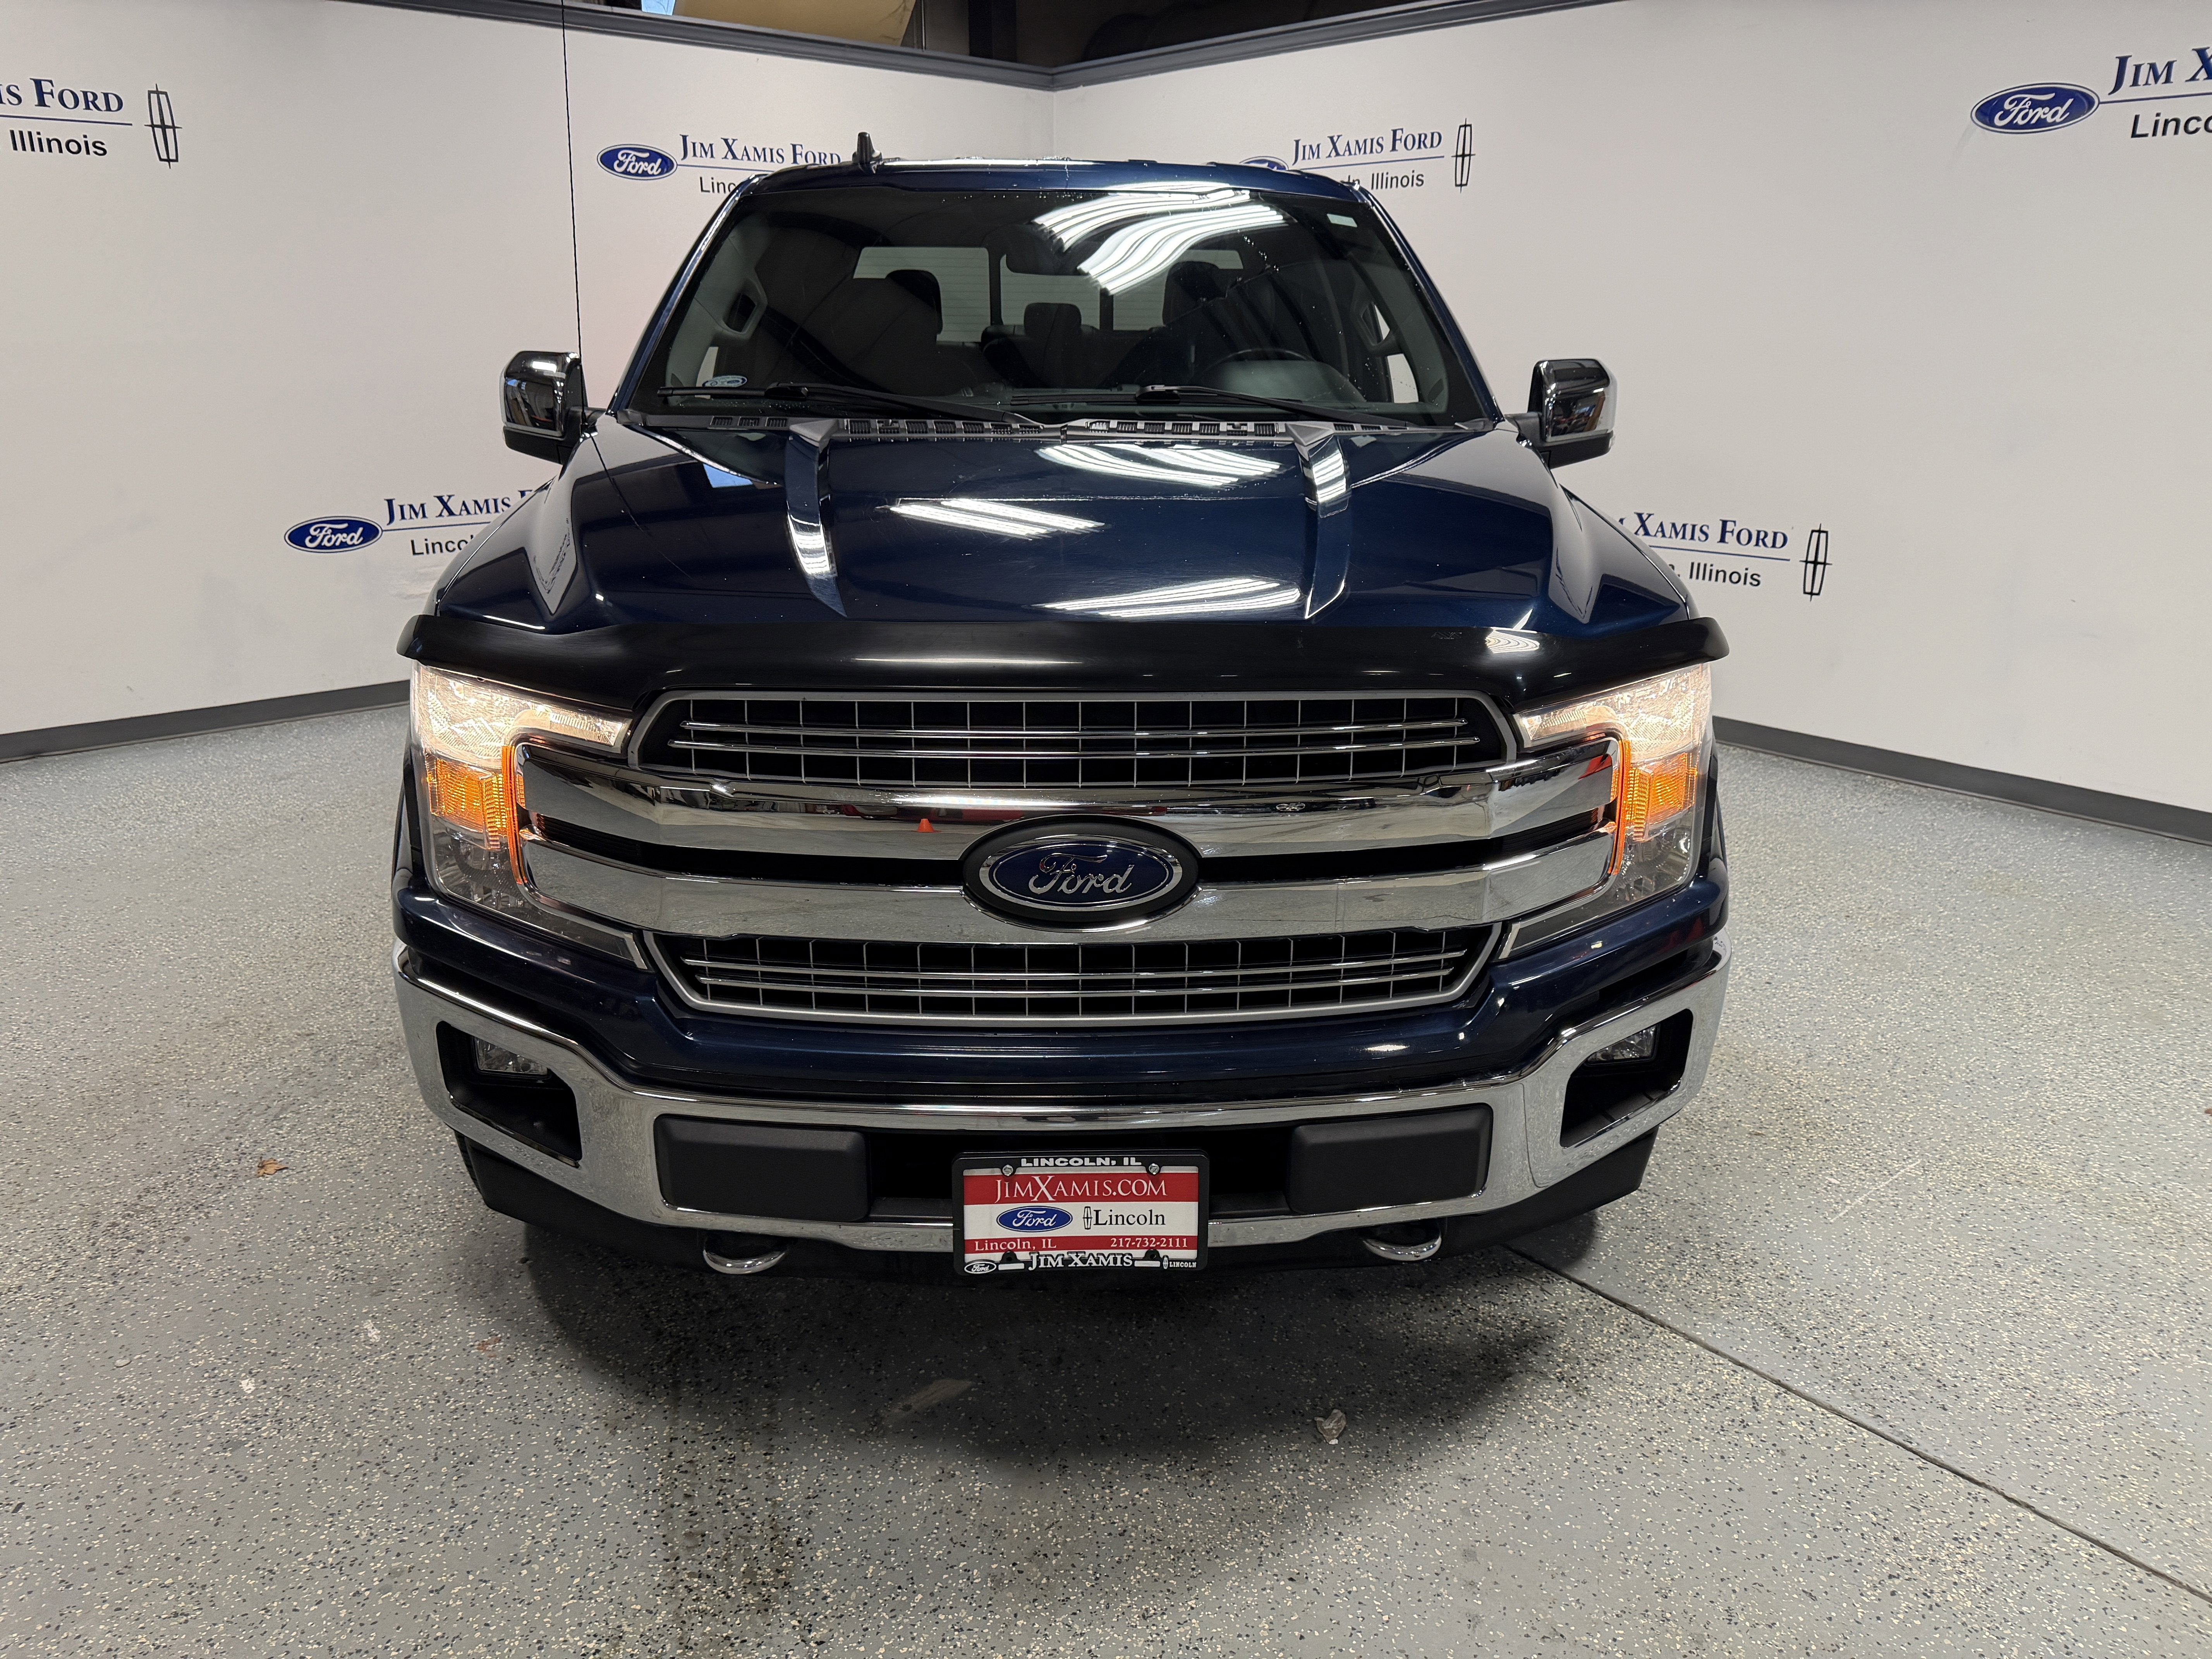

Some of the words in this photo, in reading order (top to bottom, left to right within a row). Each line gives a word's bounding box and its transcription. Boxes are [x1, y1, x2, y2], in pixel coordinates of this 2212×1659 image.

[2109, 55, 2177, 95] JIM
[29, 78, 124, 112] FORD
[1994, 92, 2074, 127] Ford
[10, 130, 107, 156] Illinois
[680, 134, 715, 161] JIM
[721, 137, 785, 164] XAMIS
[1292, 139, 1321, 165] JIM
[1326, 134, 1384, 158] XAMIS
[1390, 128, 1442, 152] FORD
[613, 149, 662, 175] Ford
[1371, 170, 1424, 190] Illinois
[384, 498, 428, 526] JIM
[433, 494, 511, 518] XAMIS
[304, 523, 364, 548] Ford
[1633, 512, 1709, 542] XAMIS
[1717, 519, 1788, 549] FORD
[410, 534, 474, 556] Linco
[1689, 562, 1761, 587] Illinois
[1028, 852, 1135, 894] Ford
[1021, 1157, 1116, 1167] LINCOLN,
[1123, 1157, 1142, 1166] IL
[994, 1175, 1168, 1204] JIMXAMIS.COM
[1012, 1209, 1056, 1227] Ford
[1093, 1209, 1166, 1226] Lincoln
[974, 1239, 1036, 1251] Lincoln,
[1042, 1238, 1057, 1249] IL
[1110, 1238, 1188, 1248] 217-732-2111
[971, 1264, 989, 1272] Ford
[1028, 1253, 1065, 1271] JIM
[1068, 1252, 1133, 1267] XAMIS
